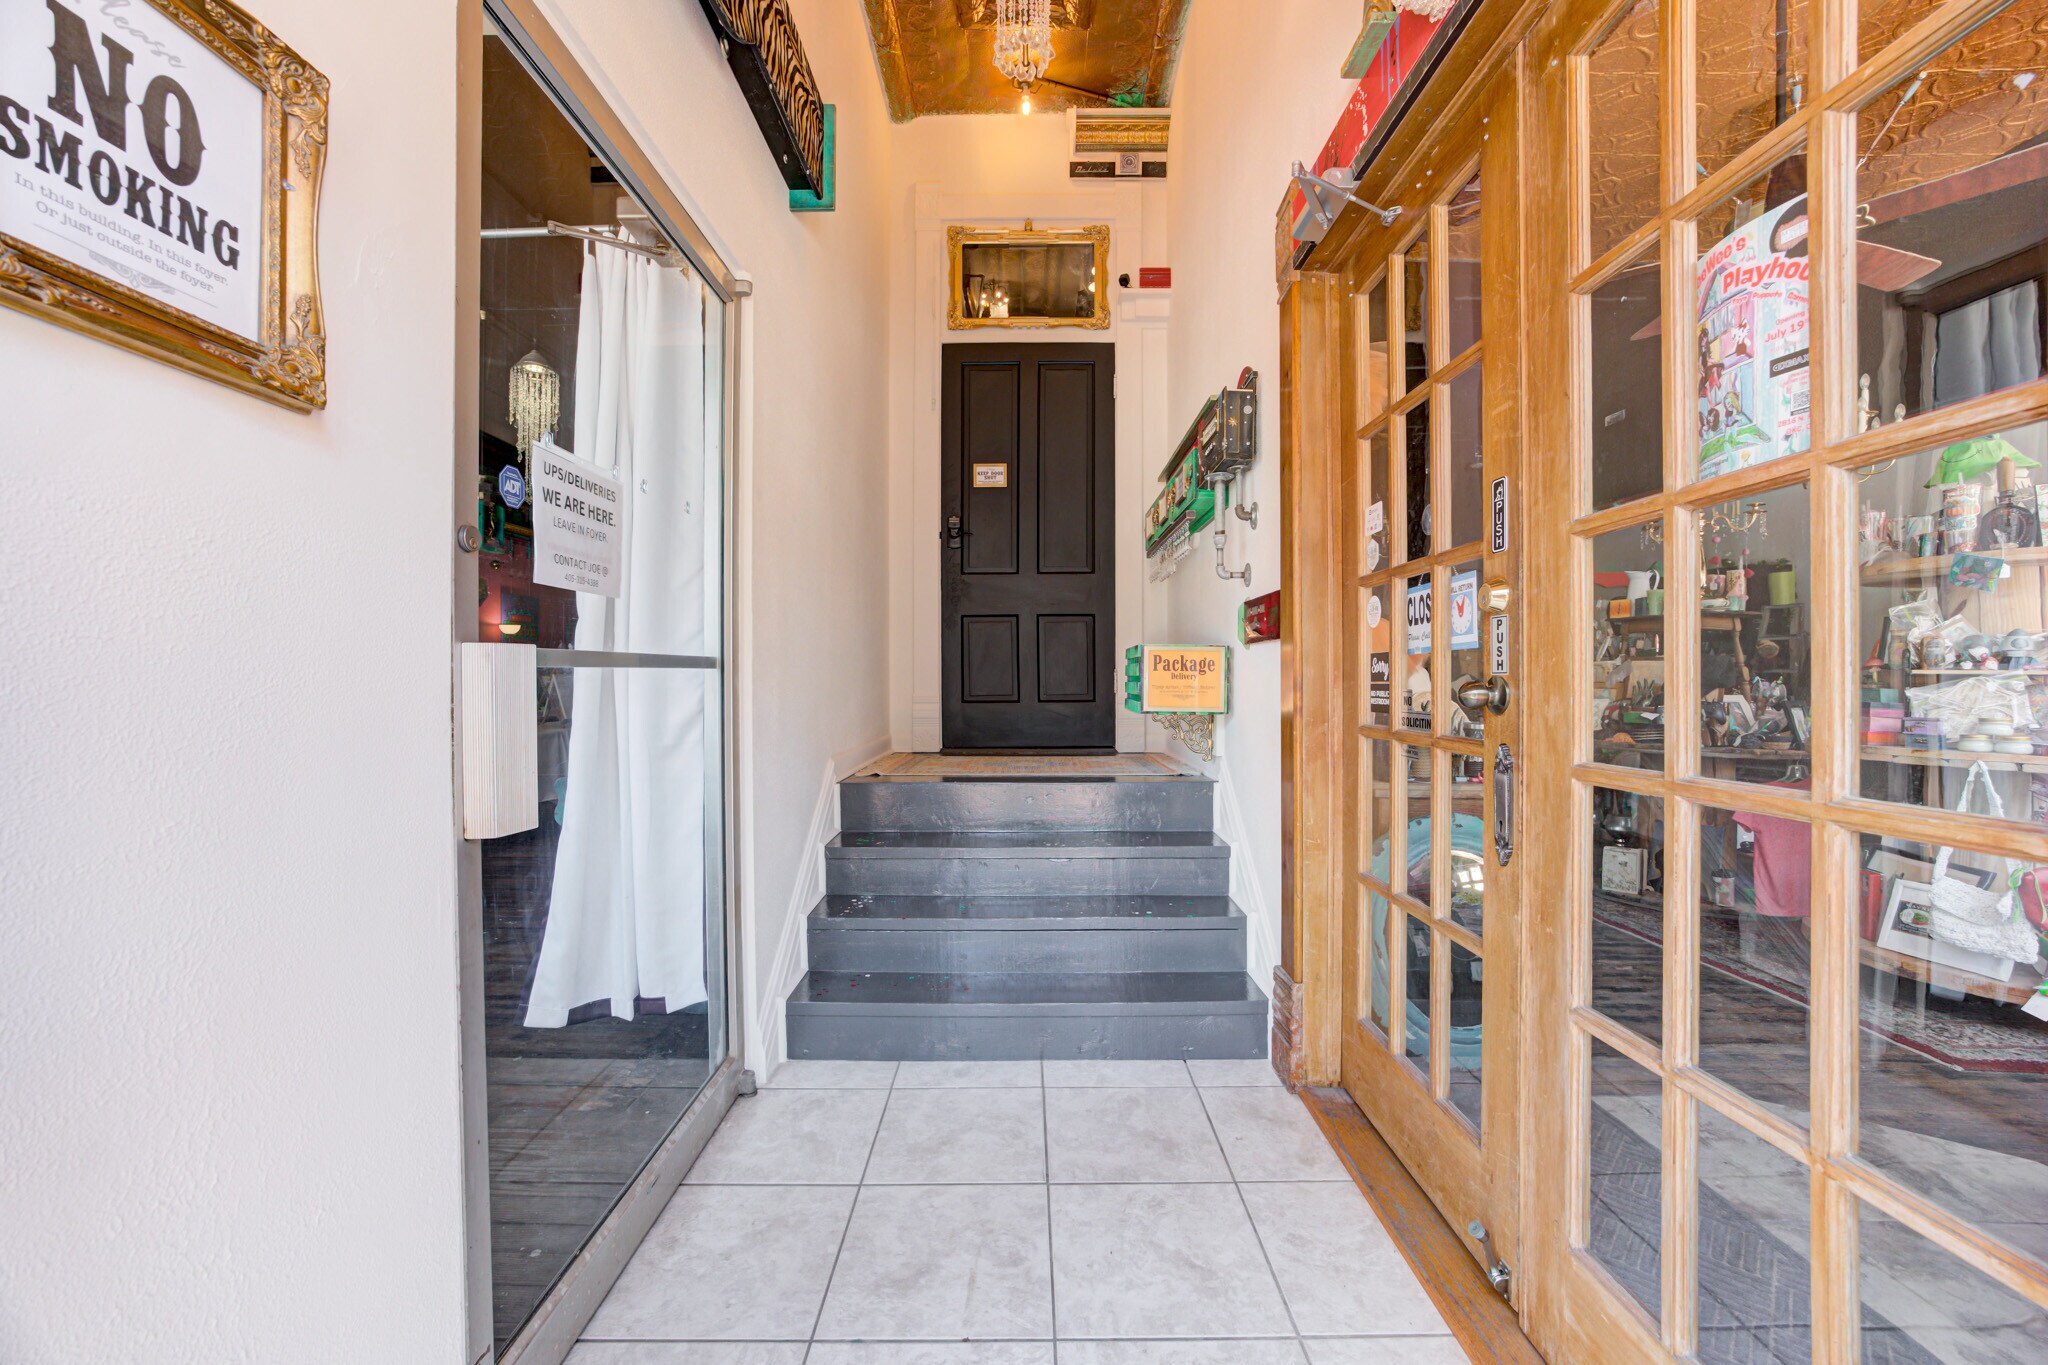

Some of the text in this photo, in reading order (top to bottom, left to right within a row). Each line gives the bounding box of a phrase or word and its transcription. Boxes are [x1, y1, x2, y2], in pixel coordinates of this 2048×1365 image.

[46, 0, 208, 187] NO
[0, 95, 240, 271] SMOKING
[13, 172, 229, 290] In this building. In this foyer.
[35, 199, 216, 296] Or just outside the foyer.
[1764, 328, 1787, 343] July
[504, 478, 521, 496] ADT
[542, 461, 617, 503] UPS/DELIVERIES
[541, 486, 562, 508] WE
[564, 498, 586, 517] ARE
[588, 503, 617, 528] HERE.
[553, 515, 576, 534] LEAVE
[577, 521, 585, 537] IN
[1495, 500, 1504, 548] PUSH
[553, 553, 609, 578] CONTACT JOE @
[1458, 581, 1474, 593] RETURN
[1495, 619, 1504, 672] PUSH
[1153, 654, 1215, 675] Package
[1171, 673, 1197, 681] Delivery
[1371, 657, 1390, 681] Sorry
[1403, 695, 1412, 707] NO
